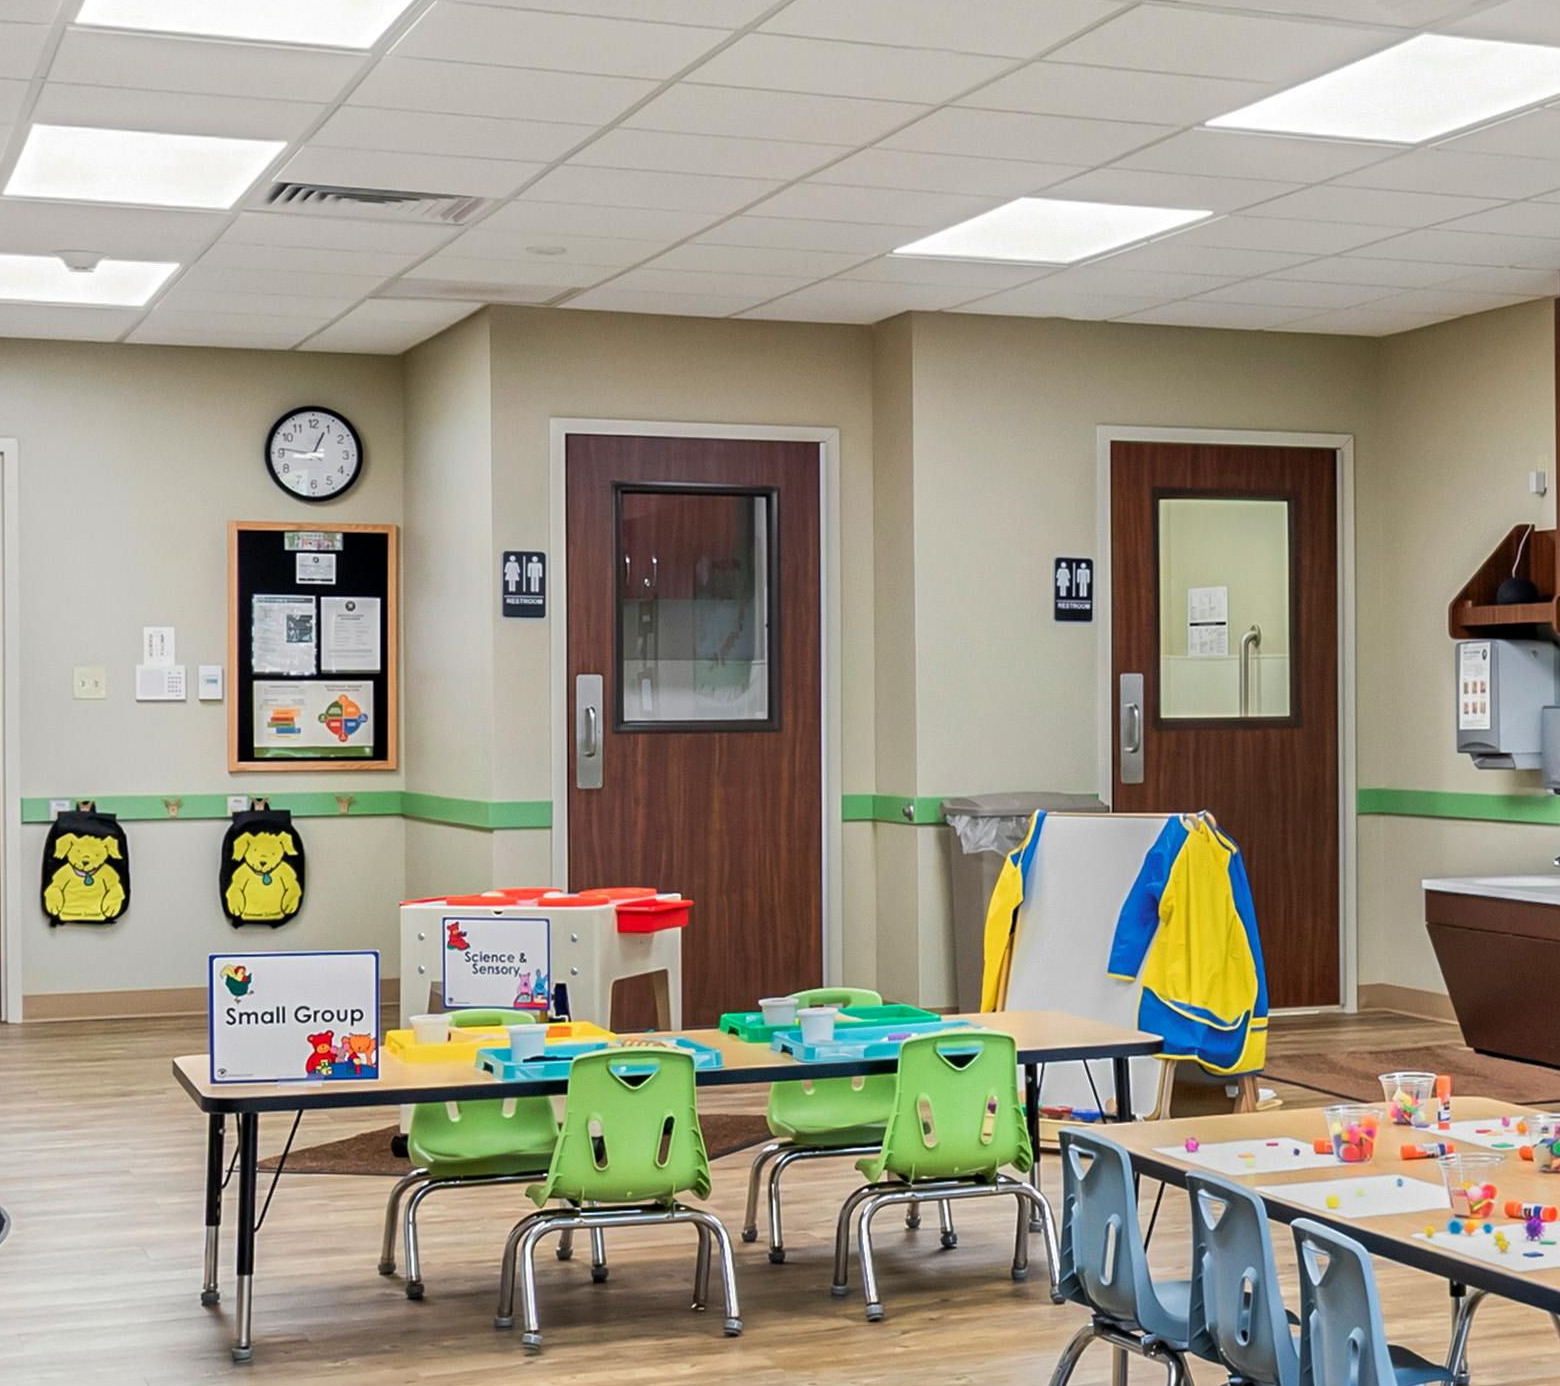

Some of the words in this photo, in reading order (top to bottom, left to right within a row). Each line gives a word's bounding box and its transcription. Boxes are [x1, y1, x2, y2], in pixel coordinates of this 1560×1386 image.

[308, 419, 320, 429] 12
[282, 433, 293, 443] 10
[337, 434, 344, 444] 2
[342, 450, 349, 460] 3
[282, 463, 290, 473] 8
[464, 950, 514, 964] Science
[517, 952, 527, 964] &
[472, 963, 520, 978] Sensory
[225, 1005, 286, 1026] Small
[294, 1005, 364, 1028] Group
